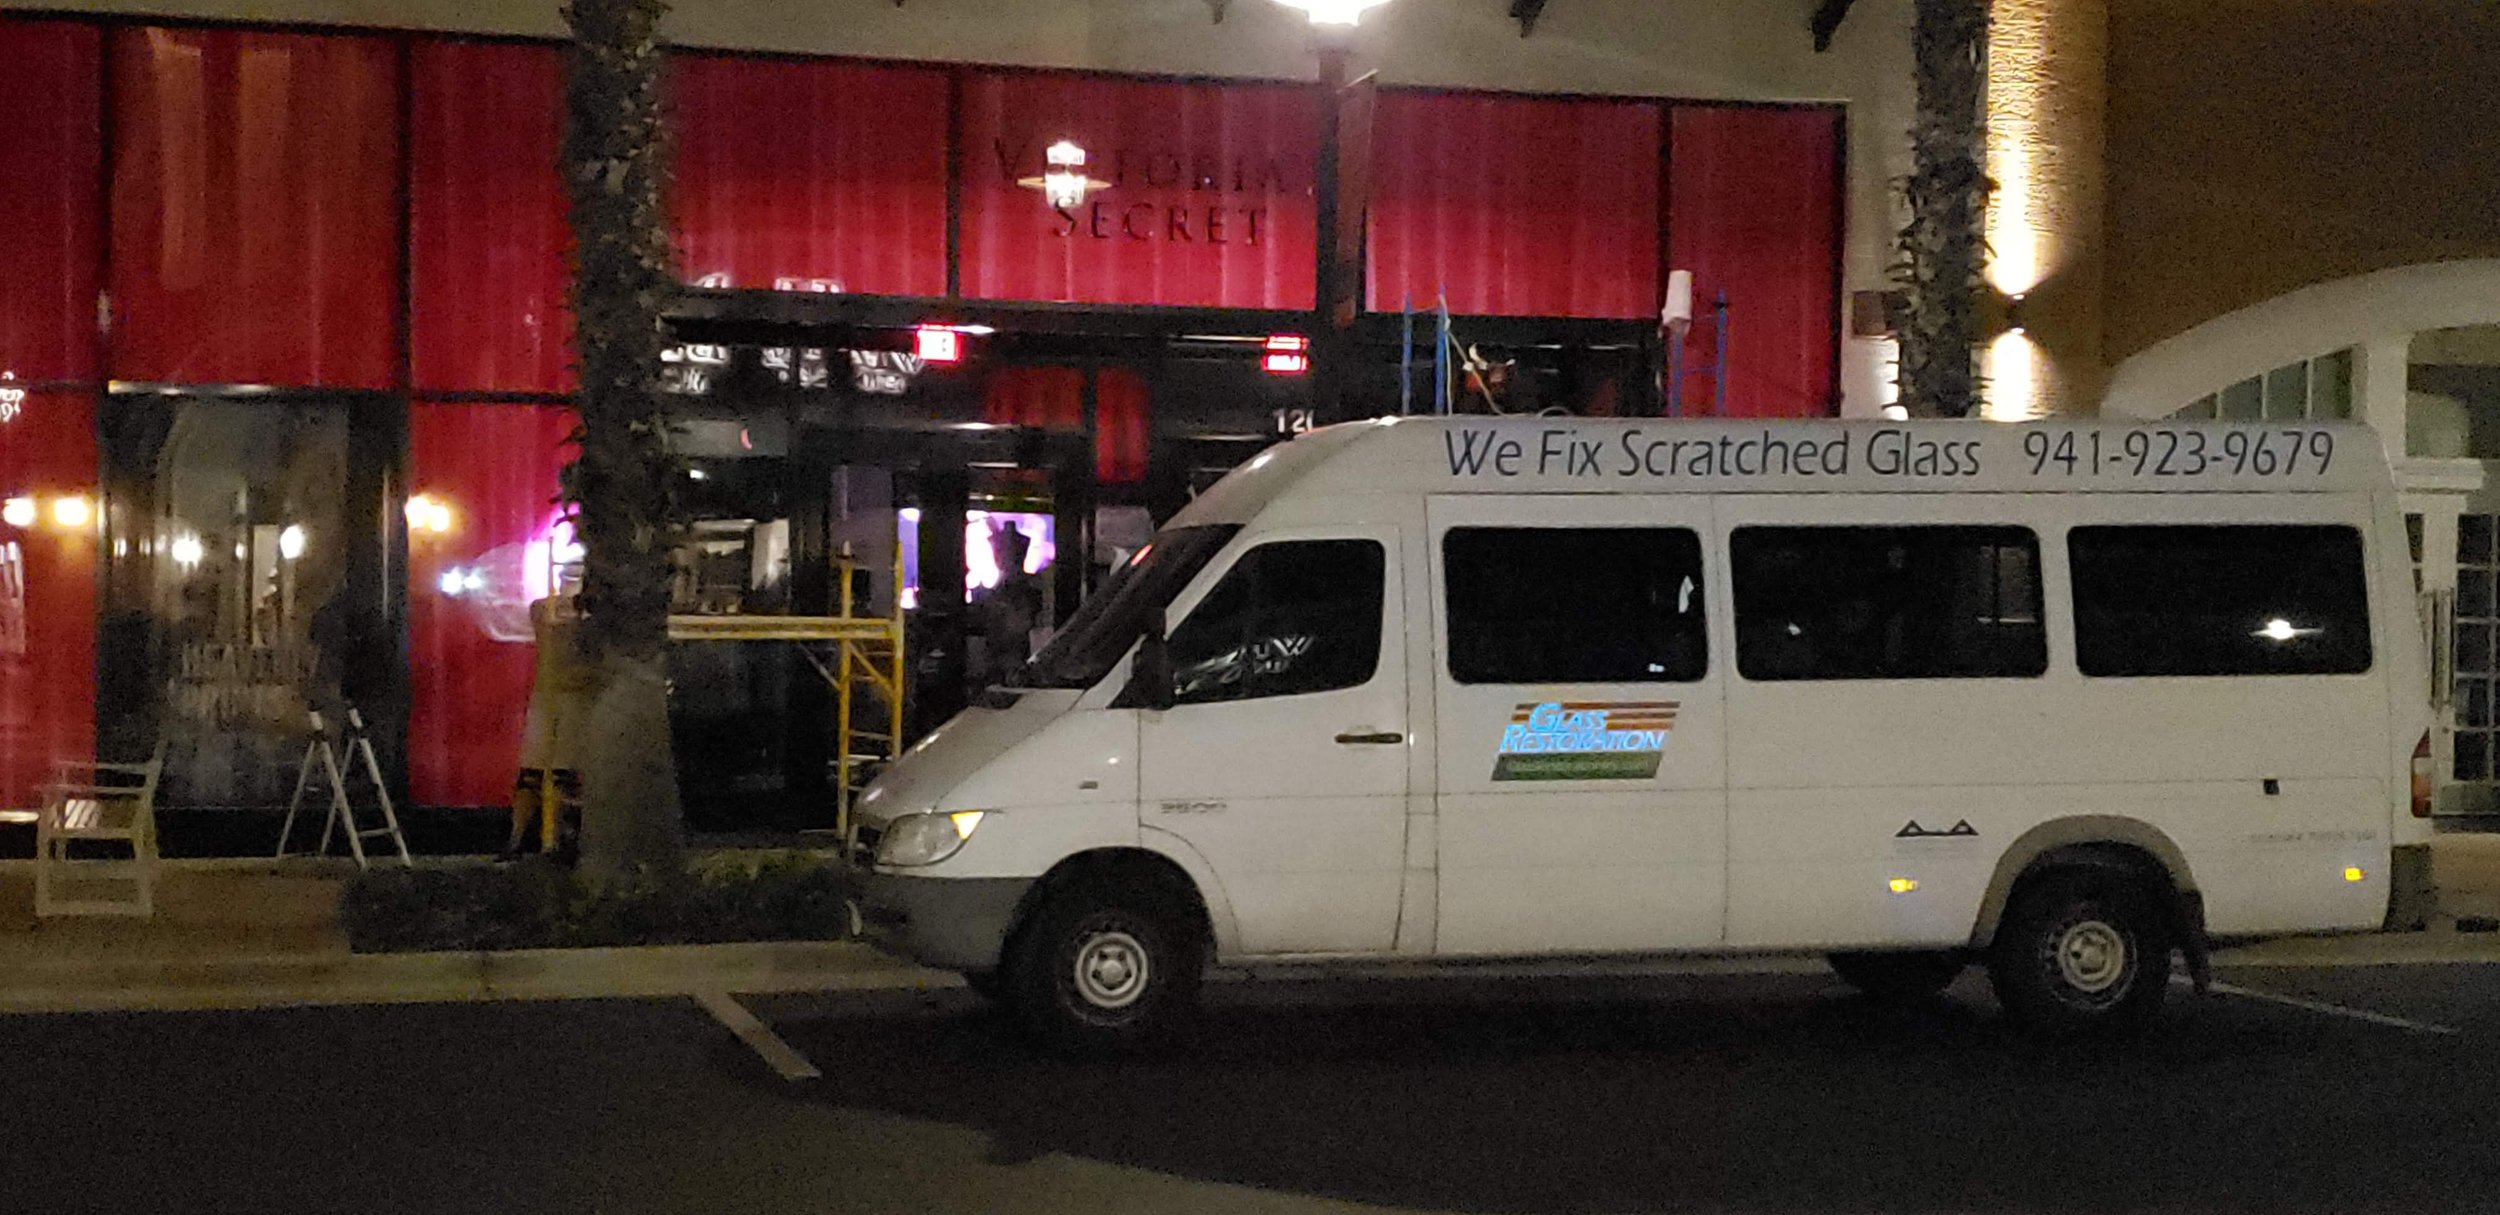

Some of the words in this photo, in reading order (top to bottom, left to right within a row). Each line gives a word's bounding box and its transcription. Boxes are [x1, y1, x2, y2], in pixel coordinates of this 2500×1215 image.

[993, 136, 1289, 194] VTORIA
[1052, 198, 1267, 246] SECRET
[1444, 429, 1523, 476] We
[1537, 429, 1603, 476] Fix
[1618, 429, 1849, 476] Scratched
[1866, 429, 1982, 476] Glass
[2022, 430, 2334, 476] 941-923-9679
[1499, 723, 1668, 752] RESTORATION
[1529, 702, 1610, 732] GLASS
